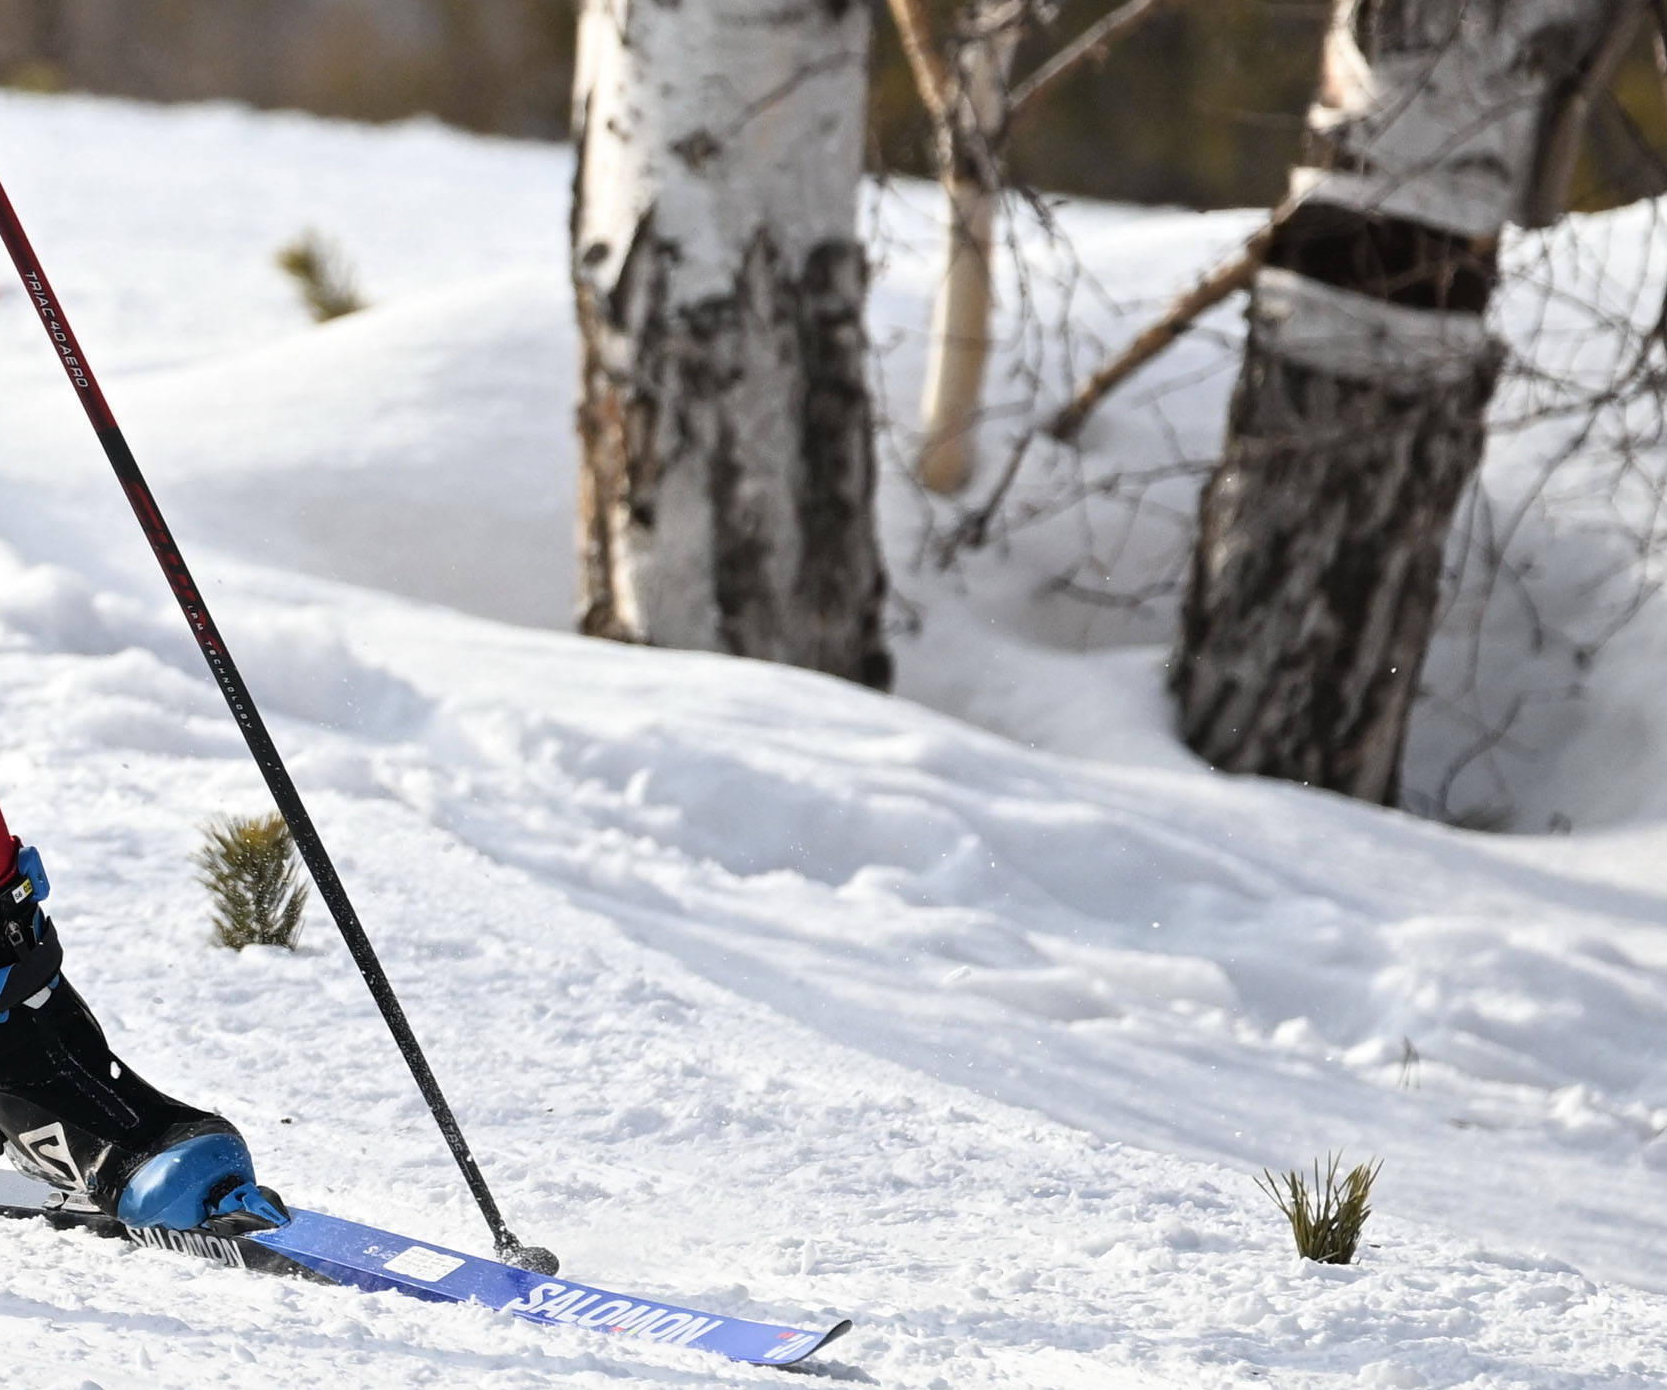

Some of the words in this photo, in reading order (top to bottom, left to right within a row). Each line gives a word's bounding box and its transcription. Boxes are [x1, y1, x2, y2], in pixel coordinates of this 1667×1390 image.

[25, 271, 55, 319] TRIAC
[59, 345, 89, 388] AERO
[125, 1225, 248, 1270] SALOMON
[507, 1282, 724, 1346] SALOMON
